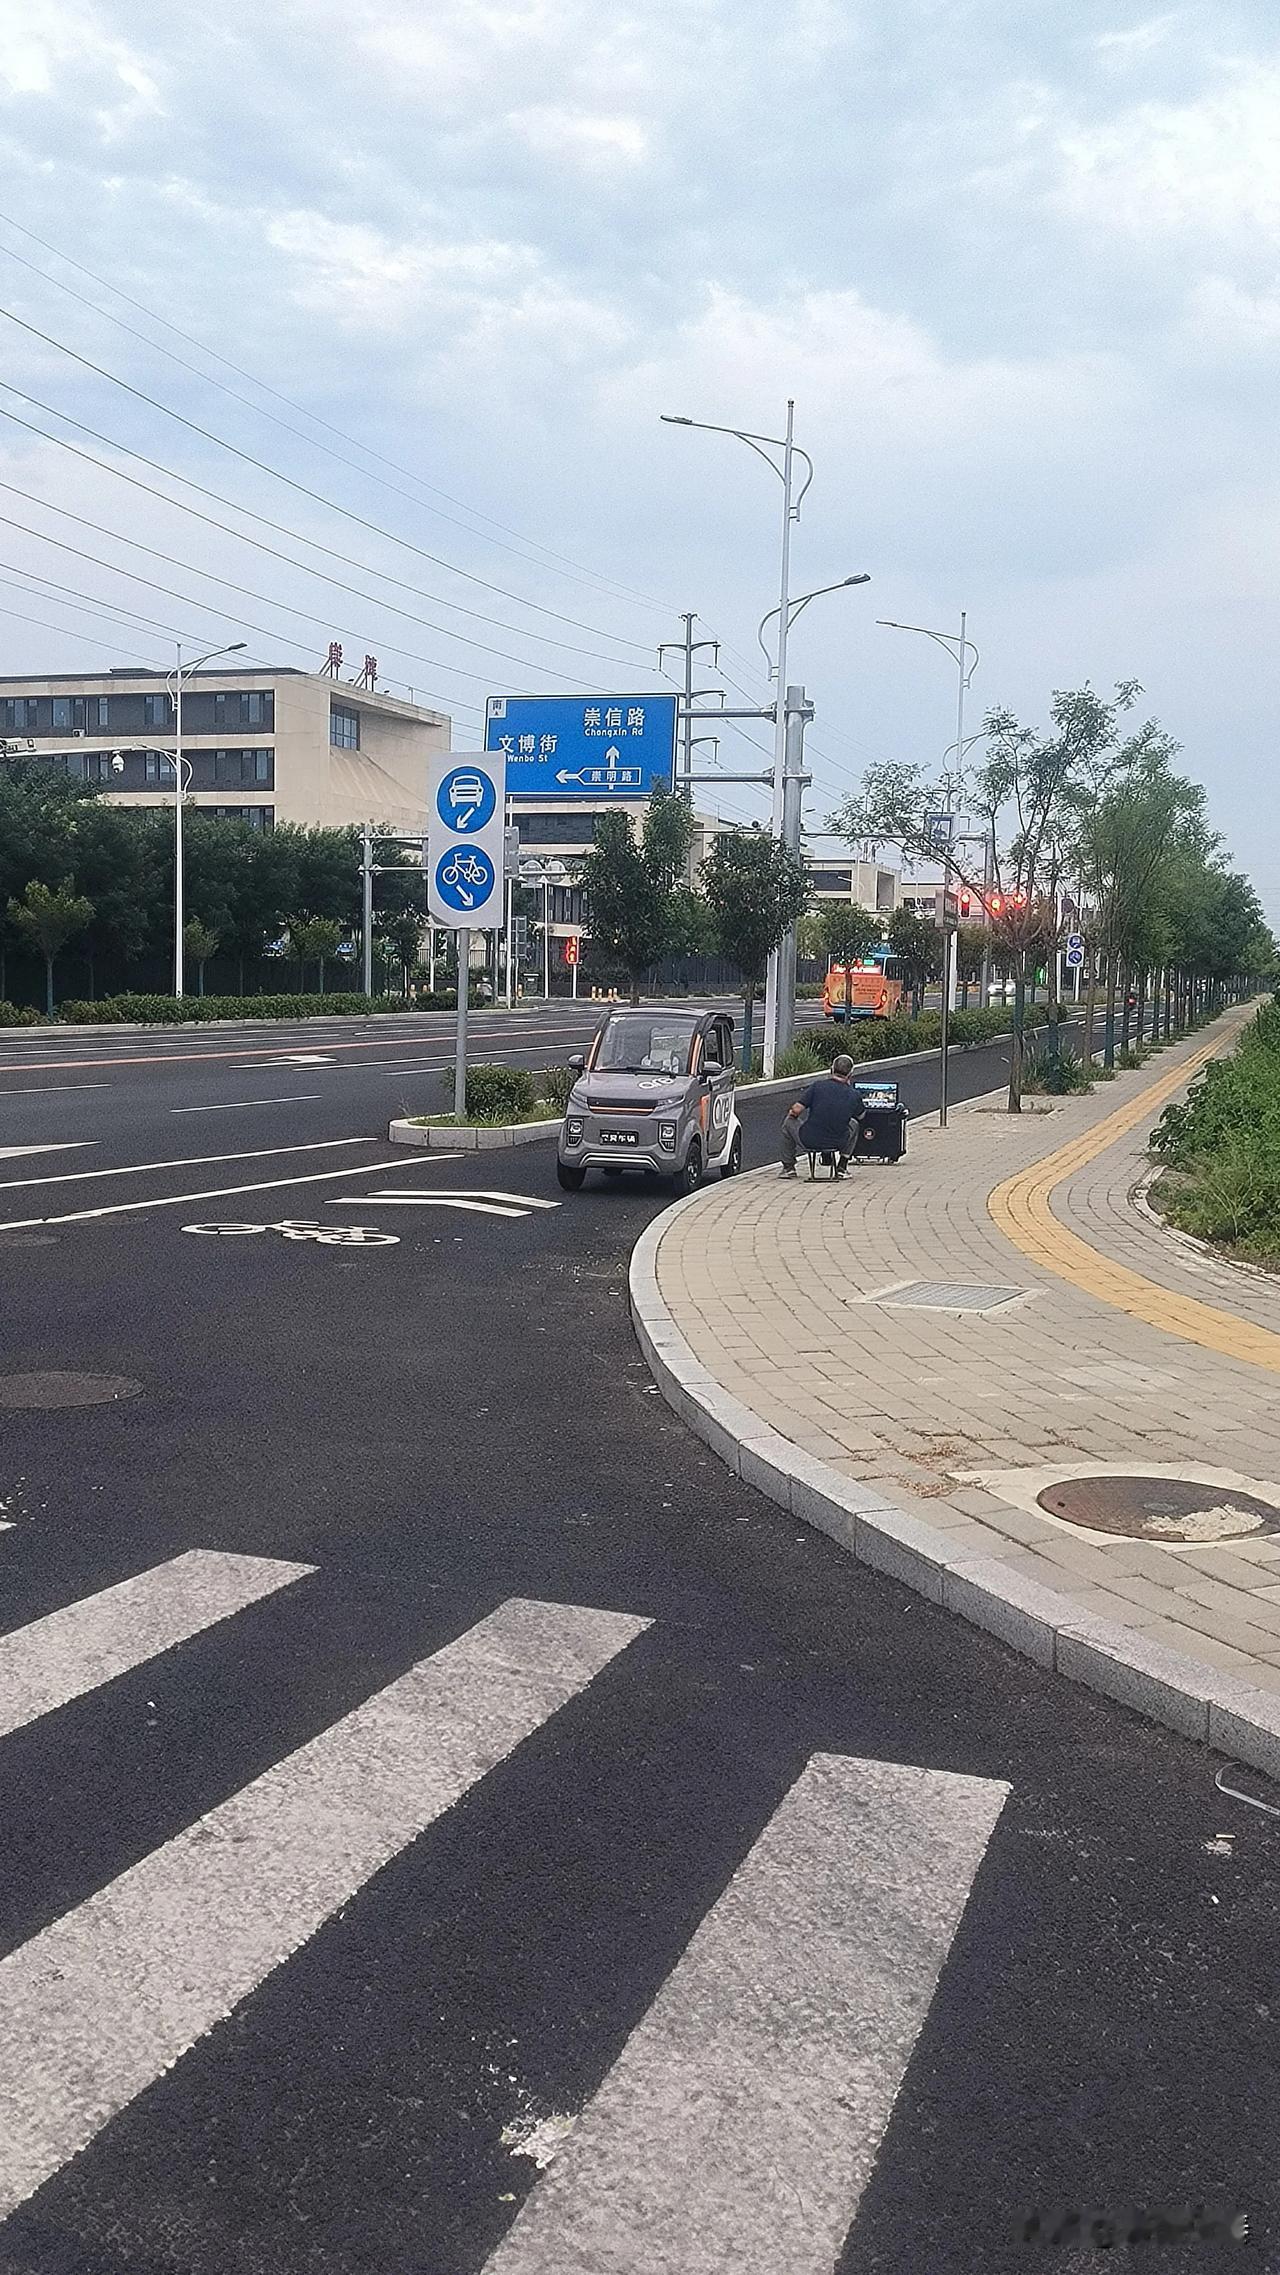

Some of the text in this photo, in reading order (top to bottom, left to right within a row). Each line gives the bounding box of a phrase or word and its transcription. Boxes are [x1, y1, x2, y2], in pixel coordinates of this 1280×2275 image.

[584, 707, 645, 727] 崇信路
[584, 728, 643, 738] Chongxin Rd
[499, 734, 558, 753] 文博街
[507, 755, 548, 763] Wenbo St
[591, 770, 633, 782] 崇明路
